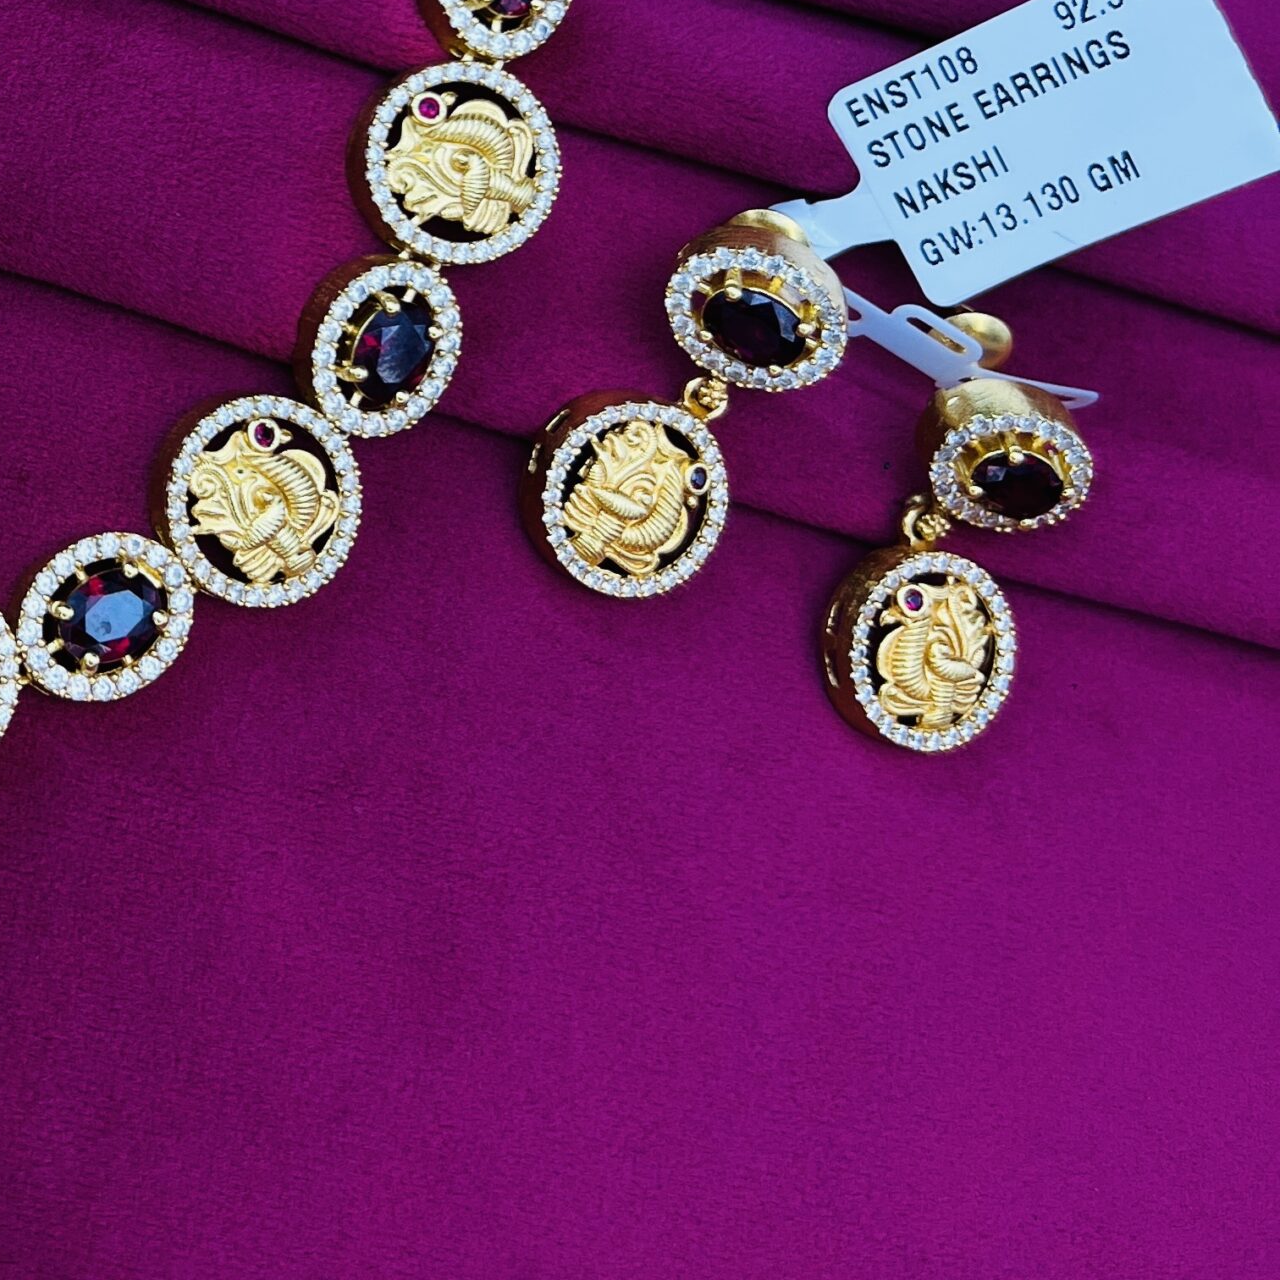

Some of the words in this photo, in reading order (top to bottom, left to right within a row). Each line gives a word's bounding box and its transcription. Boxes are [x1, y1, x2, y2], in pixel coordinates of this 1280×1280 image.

[845, 46, 979, 127] ENST108
[867, 103, 970, 168] STONE
[974, 30, 1131, 119] EARRINGS
[892, 145, 1010, 219] NAKSHI
[919, 176, 1080, 266] GW:13.130
[1088, 150, 1141, 192] GM
